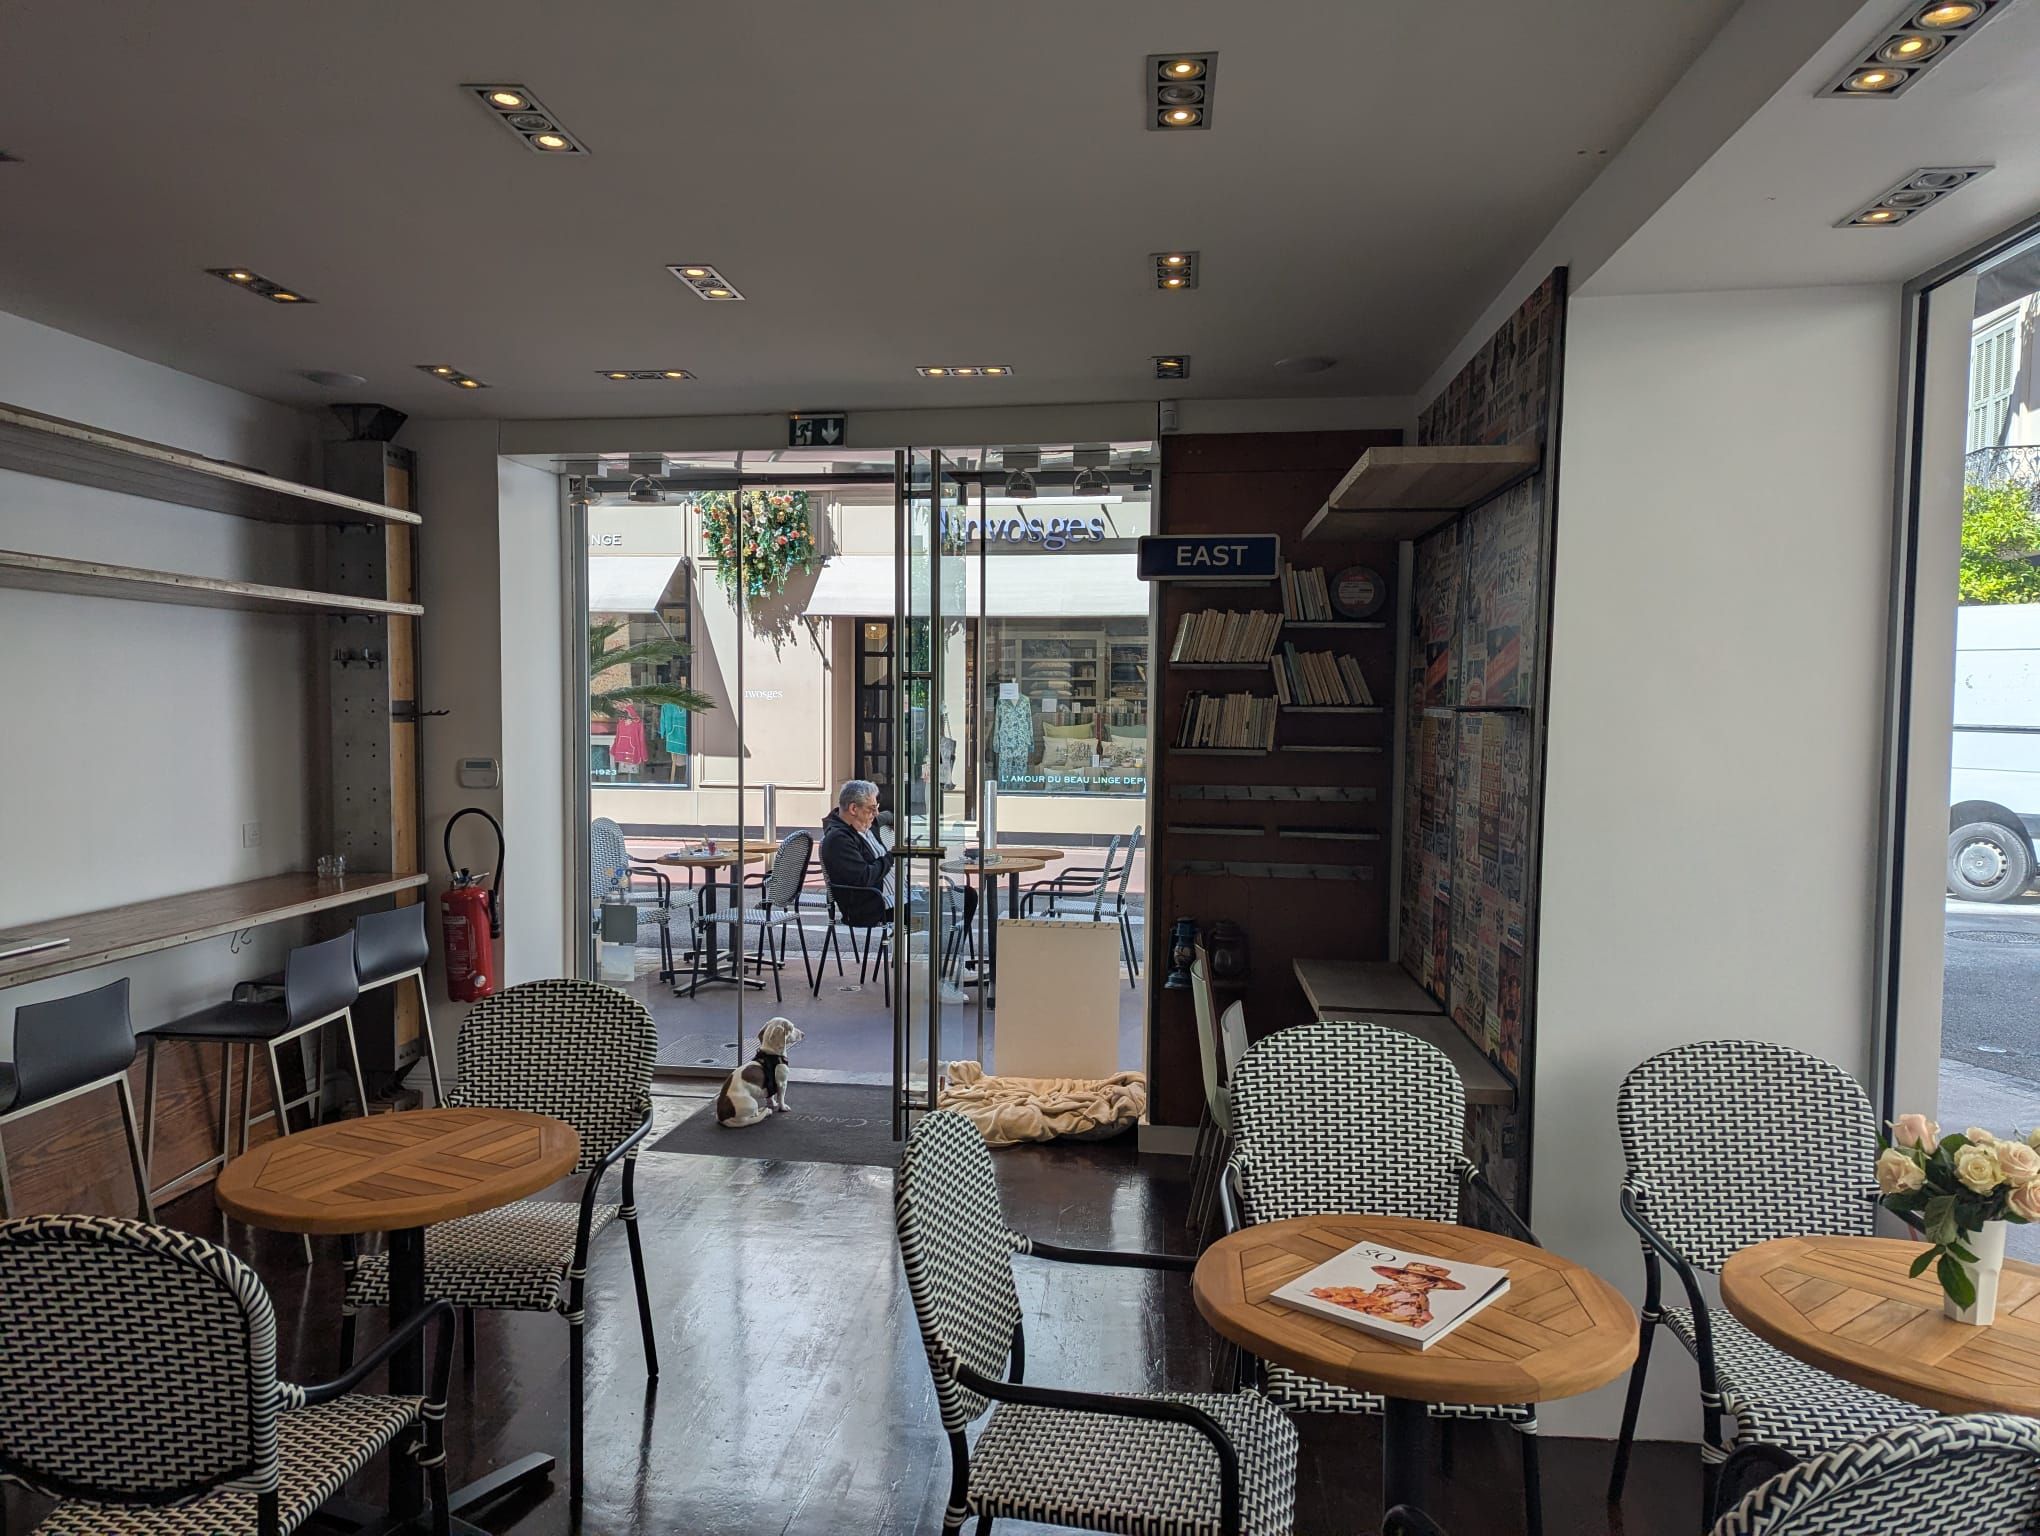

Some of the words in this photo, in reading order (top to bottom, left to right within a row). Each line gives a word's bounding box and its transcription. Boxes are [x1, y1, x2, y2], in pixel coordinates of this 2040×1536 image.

[589, 534, 622, 546] NGE
[1176, 545, 1249, 567] EAST
[1048, 775, 1061, 783] DU
[1063, 776, 1090, 784] BEAU
[1093, 776, 1121, 785] LINGE
